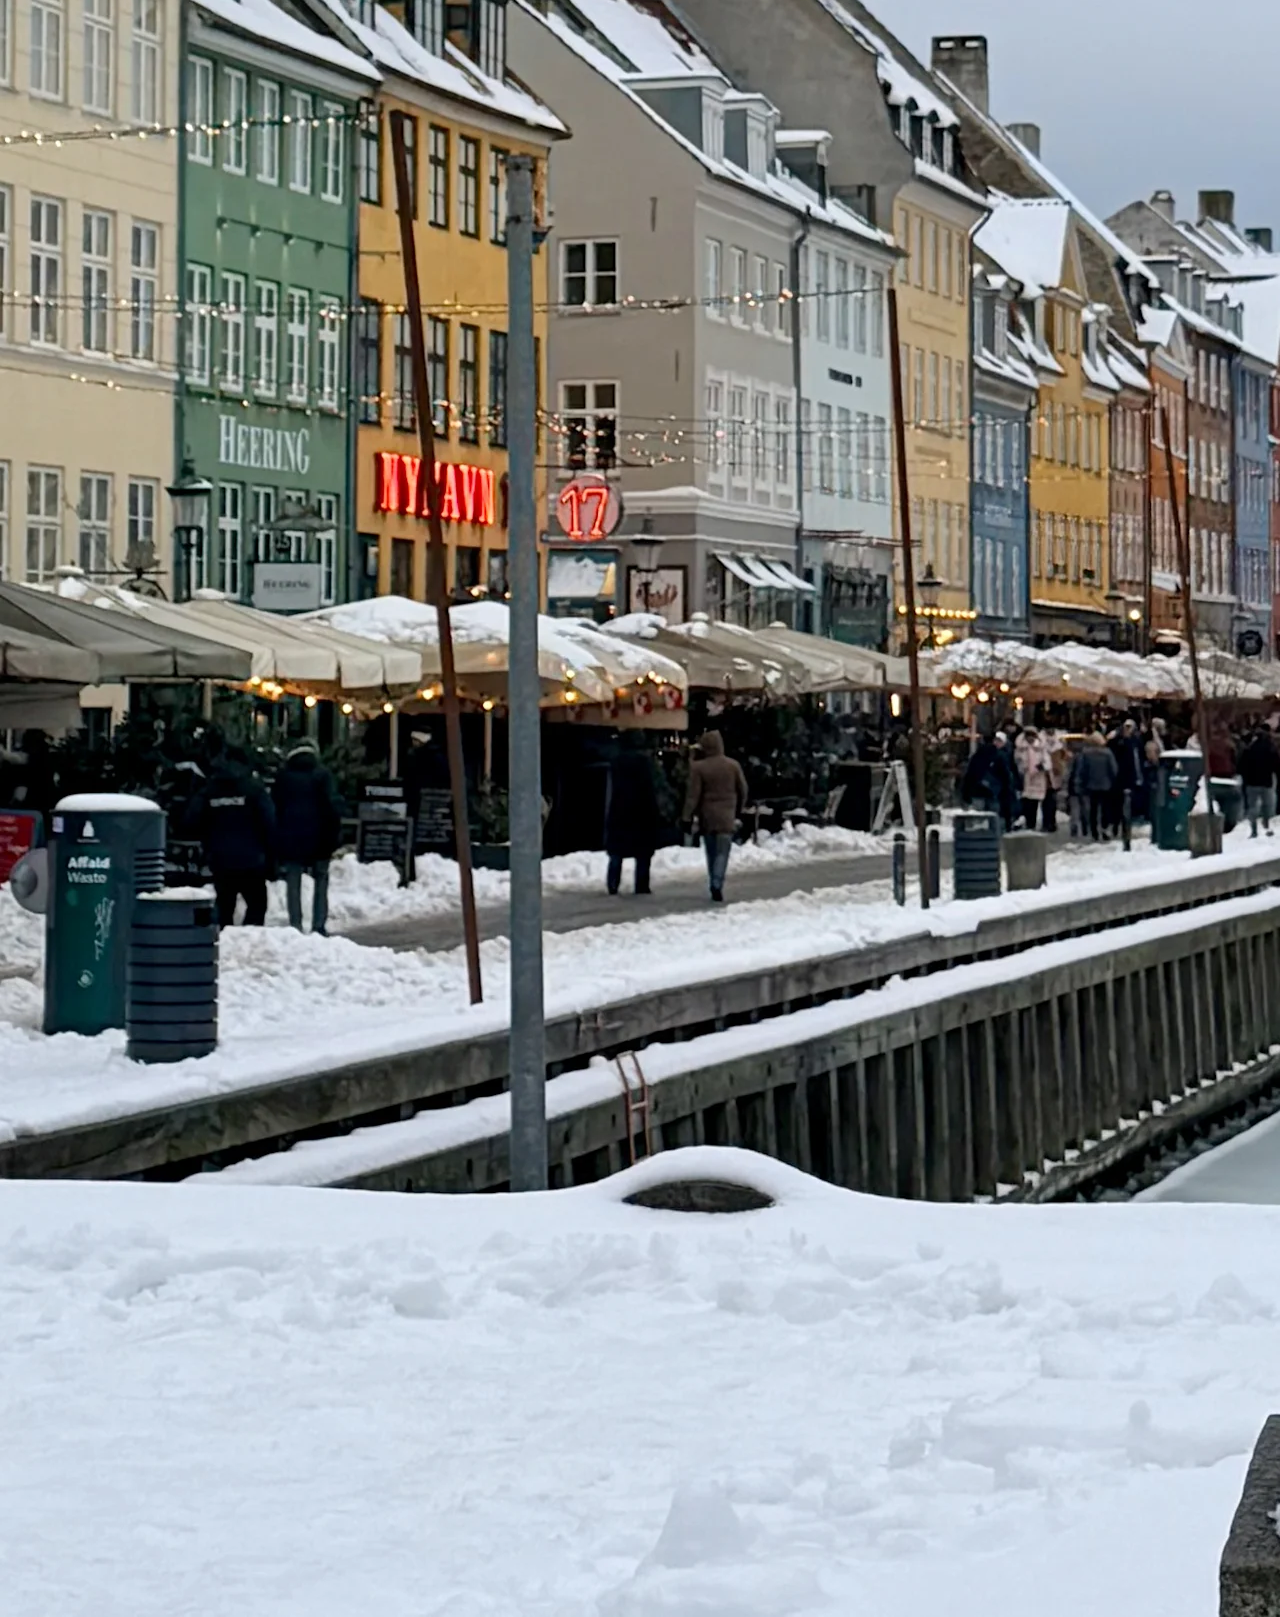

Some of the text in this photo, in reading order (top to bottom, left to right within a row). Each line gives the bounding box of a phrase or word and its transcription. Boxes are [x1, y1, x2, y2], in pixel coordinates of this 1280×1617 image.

[219, 413, 310, 474] HEERING
[374, 451, 496, 525] NYAVN
[561, 487, 609, 536] 17
[67, 871, 108, 884] Waste
[68, 856, 111, 870] Affald
